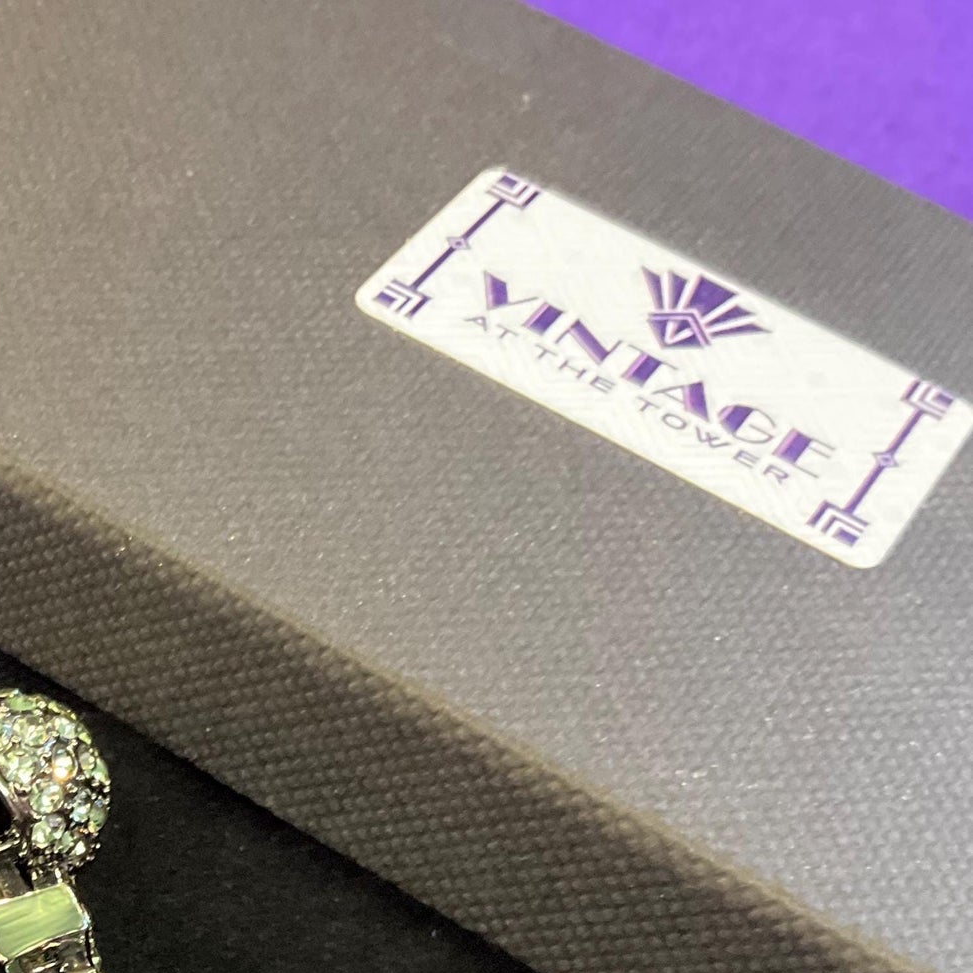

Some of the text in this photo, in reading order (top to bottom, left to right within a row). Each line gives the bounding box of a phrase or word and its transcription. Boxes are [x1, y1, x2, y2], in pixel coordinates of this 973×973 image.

[463, 314, 791, 484] AT THE TOWER
[483, 269, 836, 479] VINTAGE
